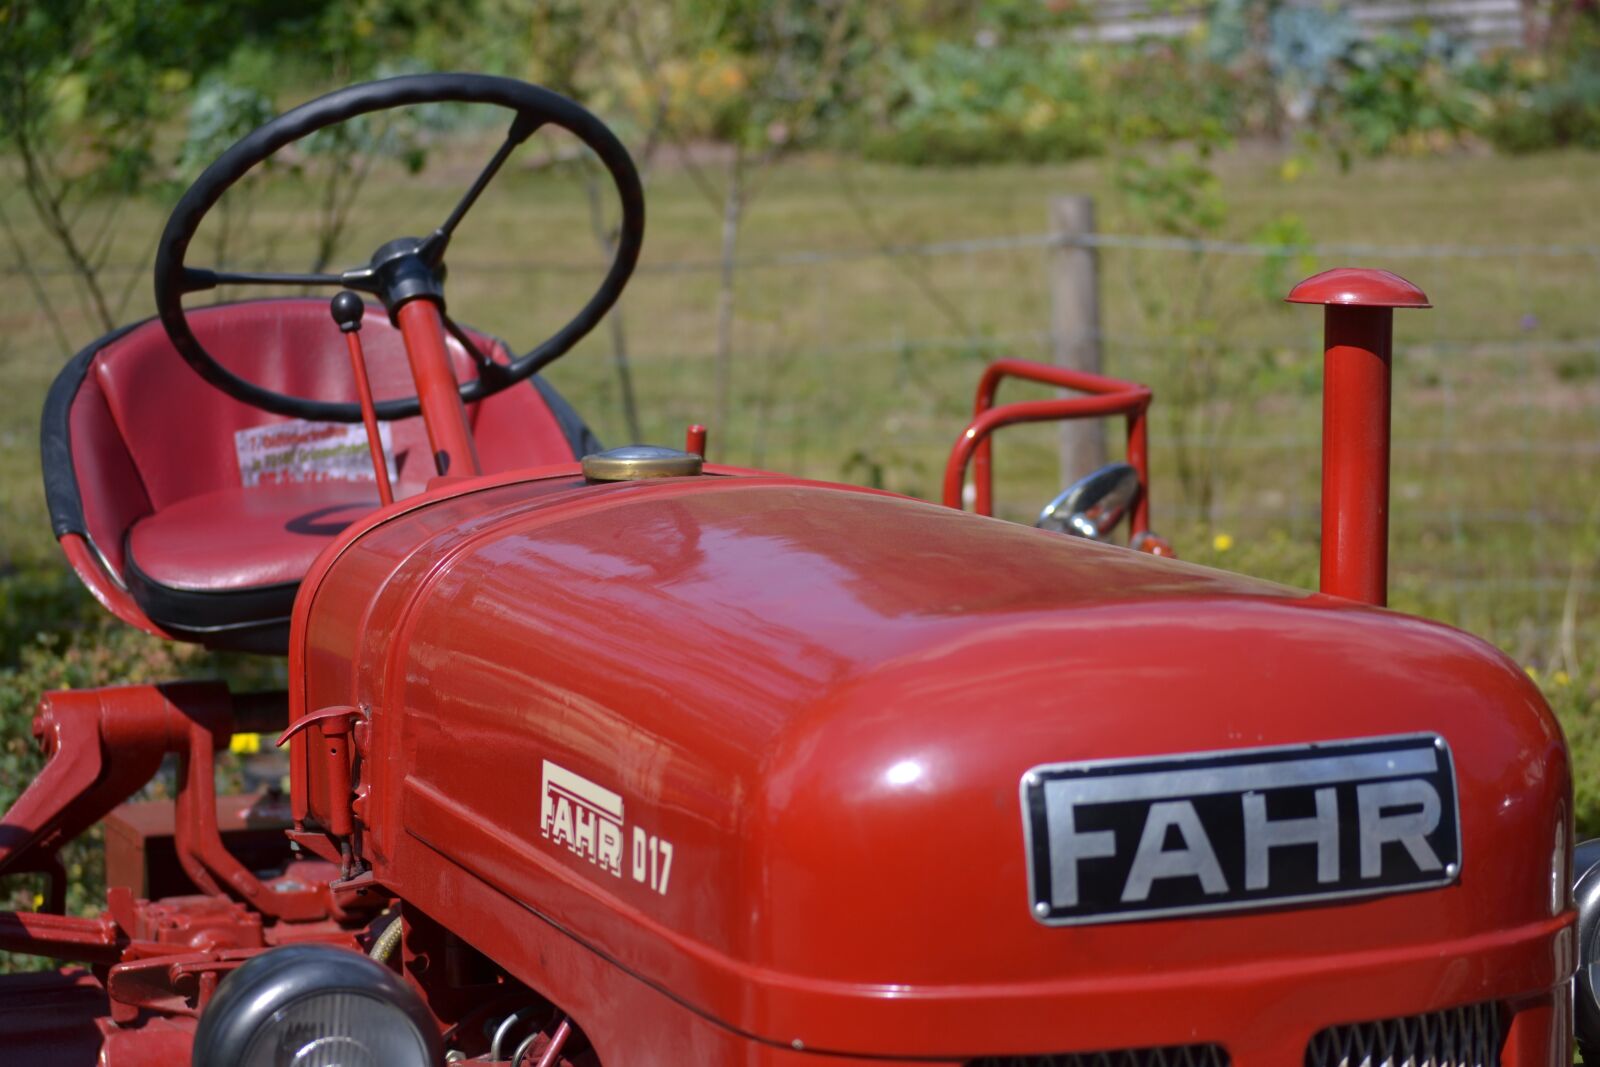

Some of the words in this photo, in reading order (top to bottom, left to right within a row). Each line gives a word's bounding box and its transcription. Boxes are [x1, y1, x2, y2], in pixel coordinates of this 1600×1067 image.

[541, 759, 624, 878] FAHR
[633, 826, 673, 896] D17
[1044, 747, 1443, 908] FAHR
